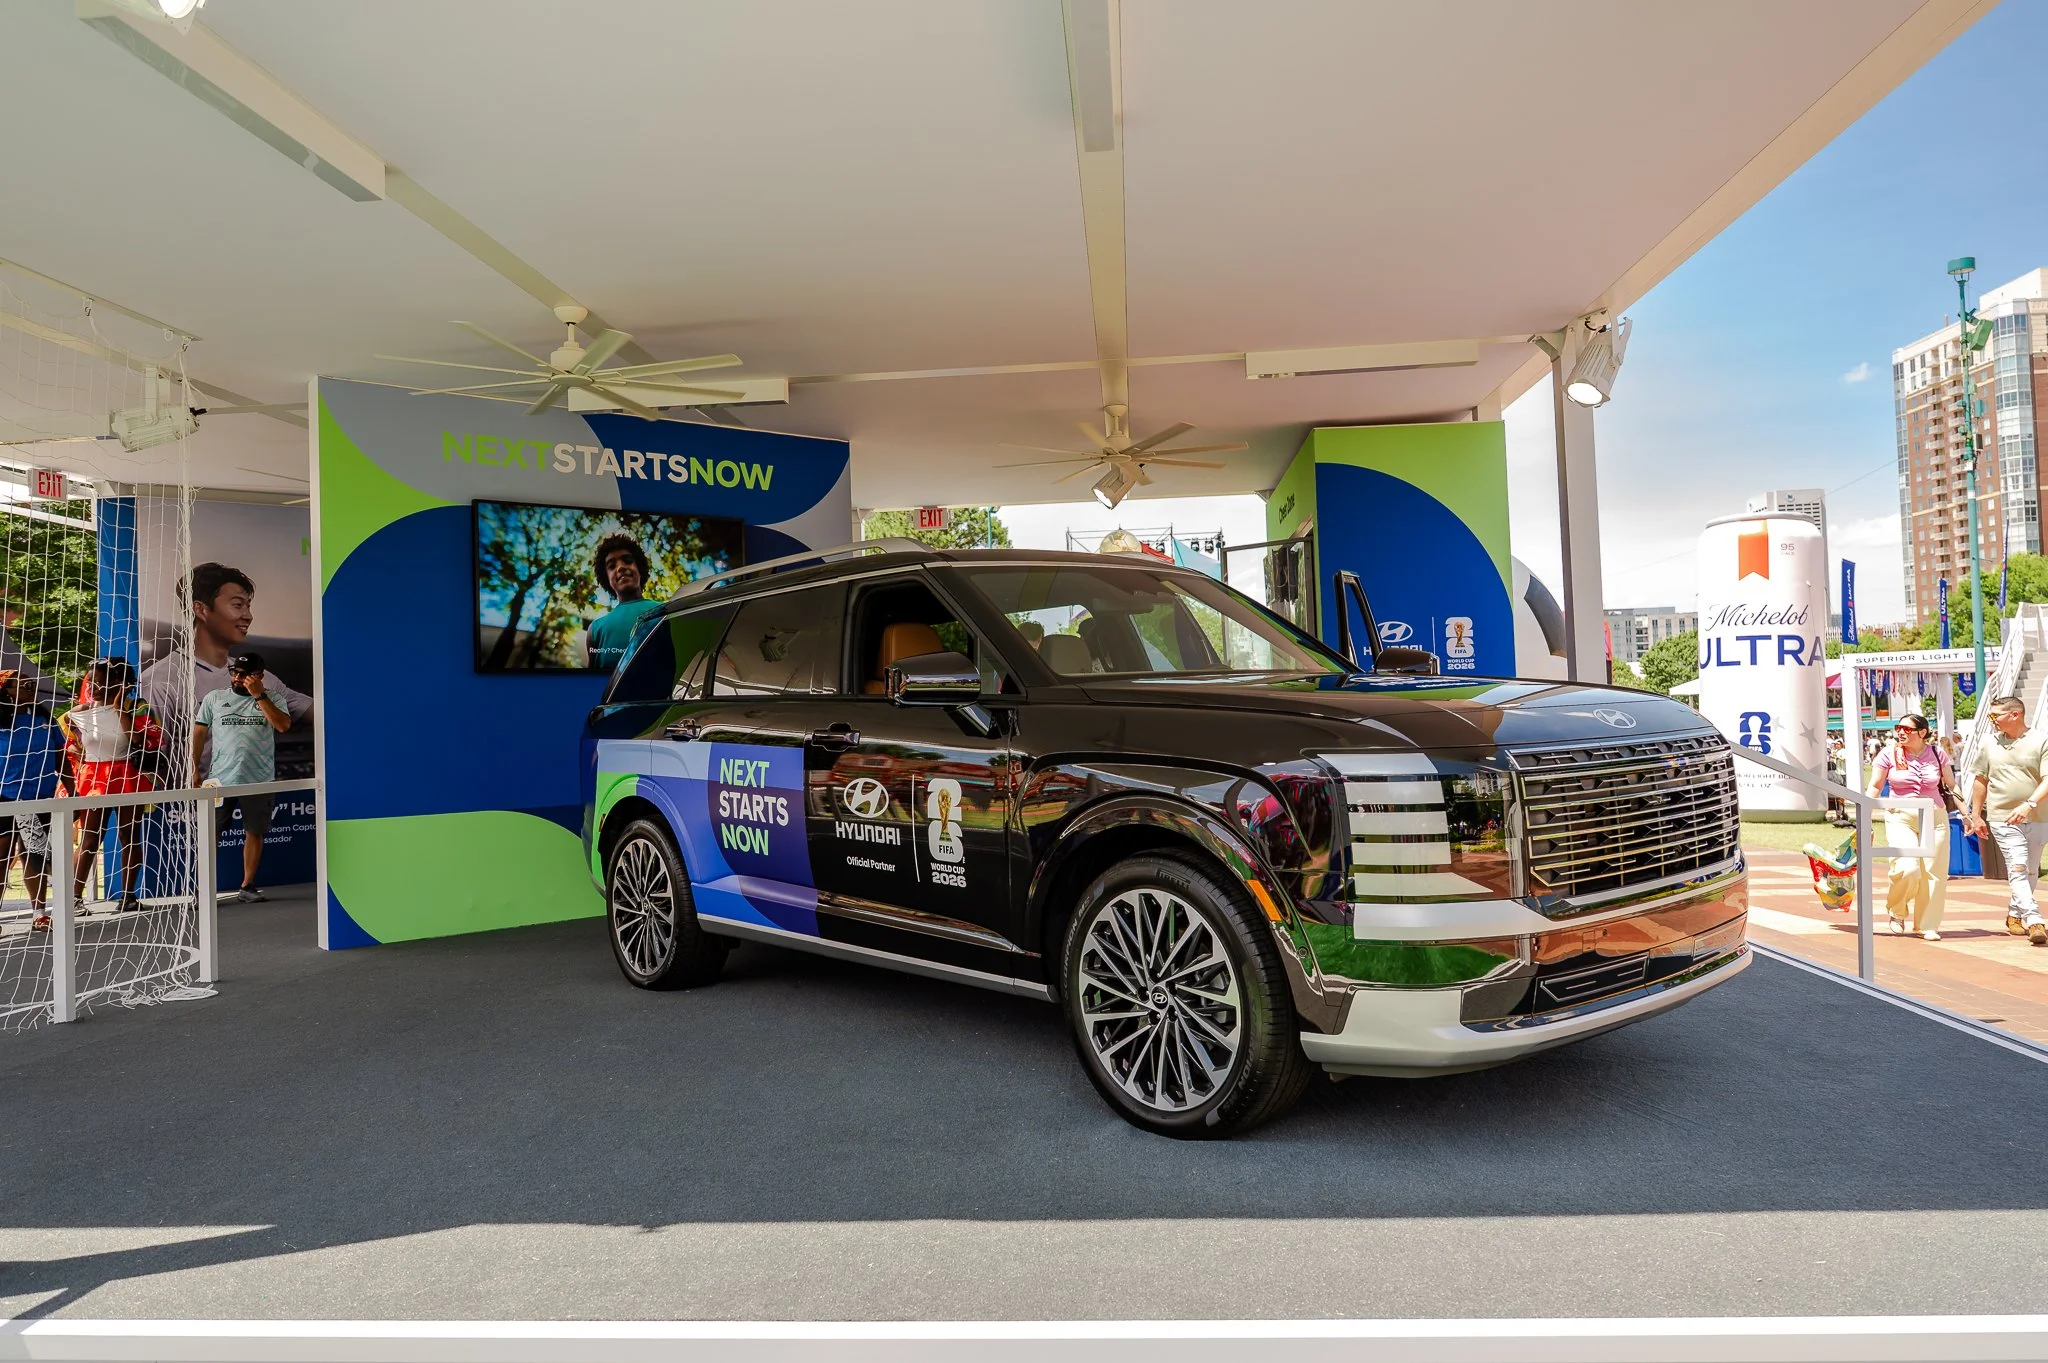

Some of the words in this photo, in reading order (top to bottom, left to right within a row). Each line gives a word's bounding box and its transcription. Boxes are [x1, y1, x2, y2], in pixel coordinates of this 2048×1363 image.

[38, 471, 63, 498] EXIT
[920, 509, 943, 528] EXIT
[1780, 543, 1795, 551] 95
[1705, 603, 1809, 632] Michelob
[1856, 655, 1915, 664] SUPERIOR
[1922, 653, 1961, 661] LIGHT
[1966, 651, 2000, 659] BER
[719, 757, 770, 789] NEXT
[718, 790, 789, 827] STARTS
[720, 822, 769, 856] NOW
[835, 820, 901, 846] HYUNDAI
[938, 844, 955, 856] FIFA
[846, 855, 870, 869] Official
[870, 859, 896, 873] Partner
[930, 861, 953, 873] WORLD
[952, 864, 966, 875] CUP
[931, 871, 967, 888] 2026
